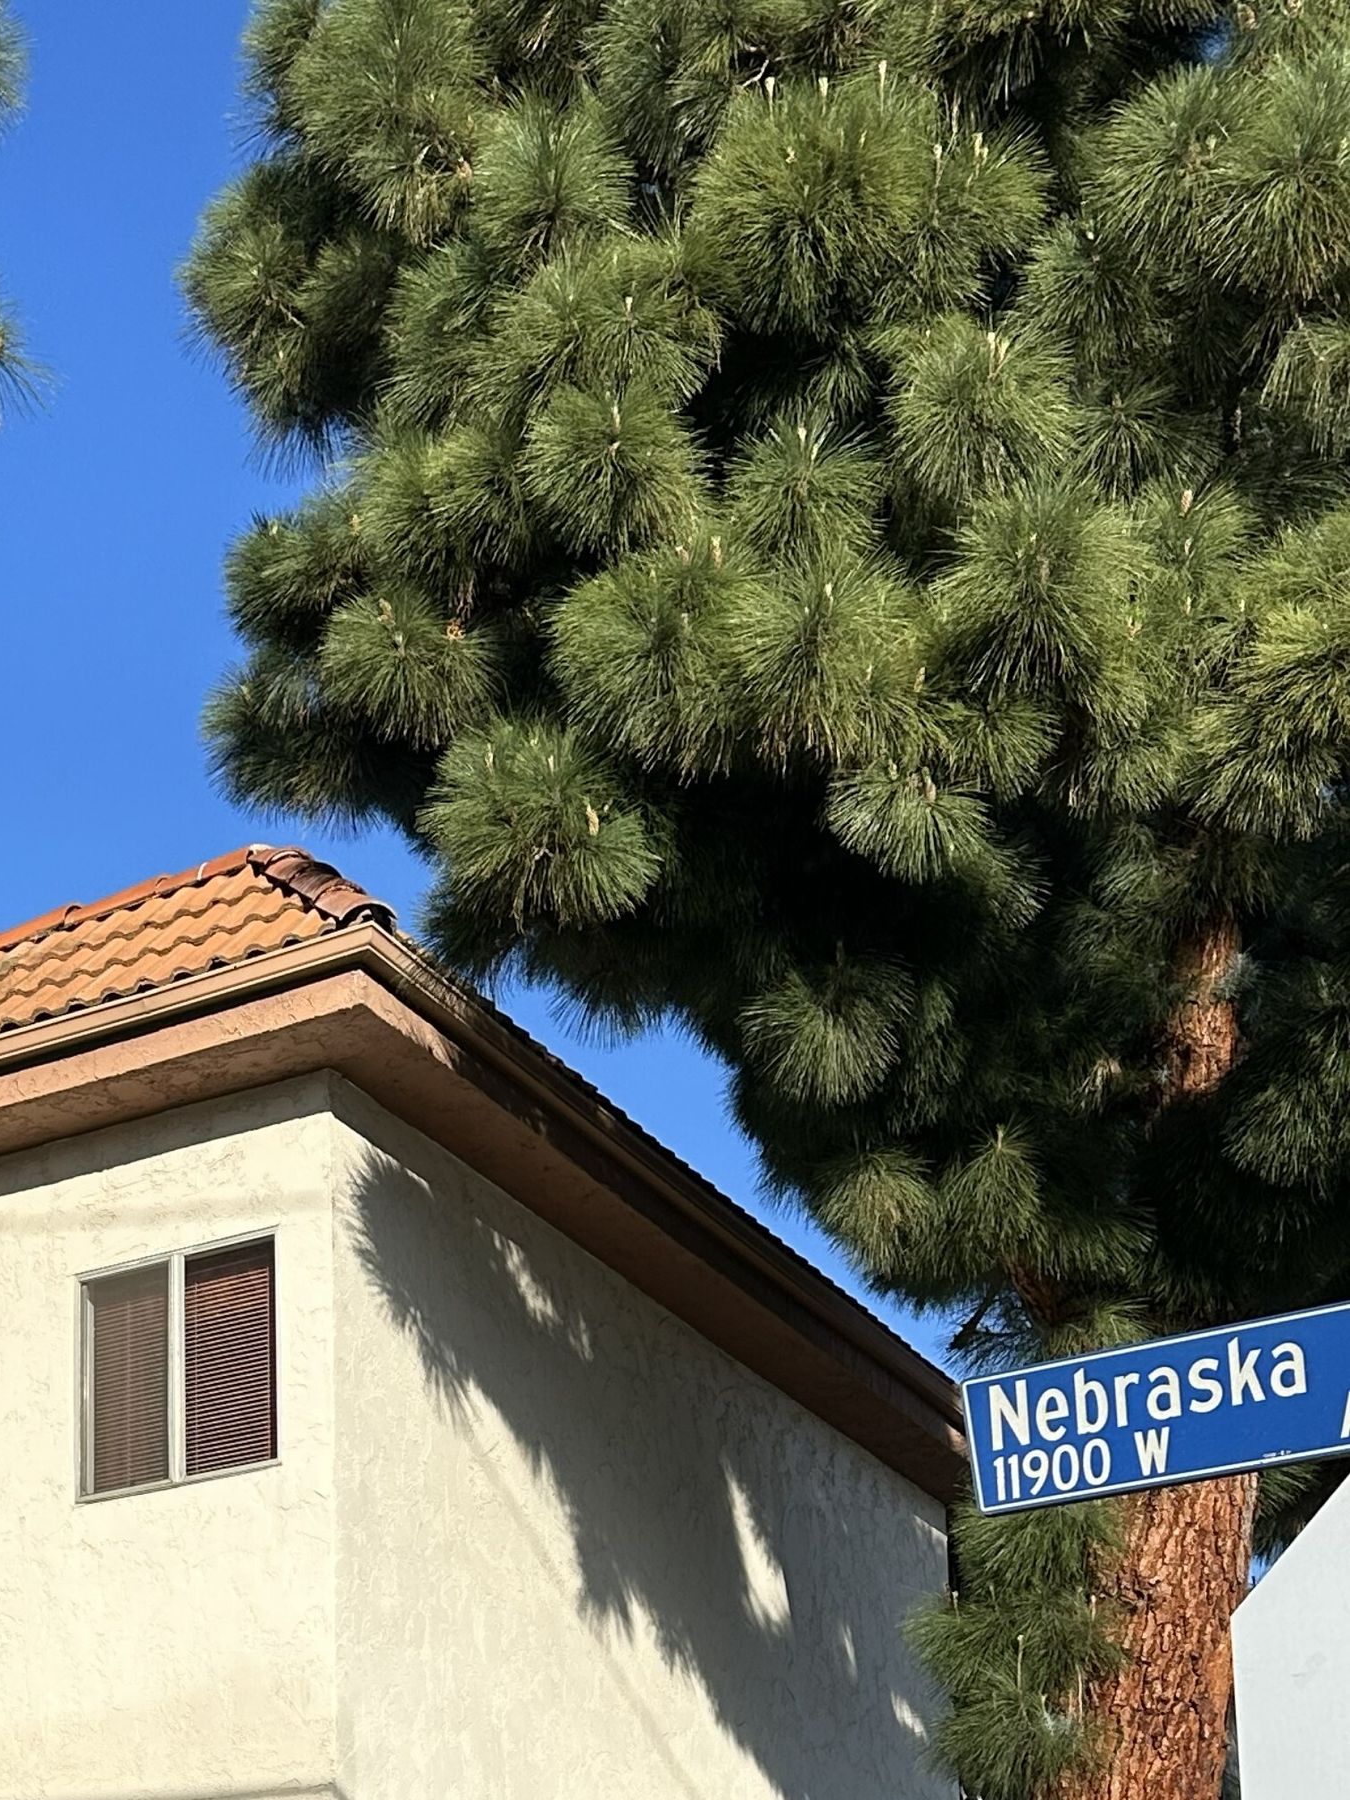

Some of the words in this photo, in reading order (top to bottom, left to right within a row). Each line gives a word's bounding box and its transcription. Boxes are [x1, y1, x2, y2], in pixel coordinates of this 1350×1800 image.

[988, 1336, 1307, 1451] Nebraska
[992, 1438, 1111, 1501] 11900
[1134, 1426, 1170, 1476] W
